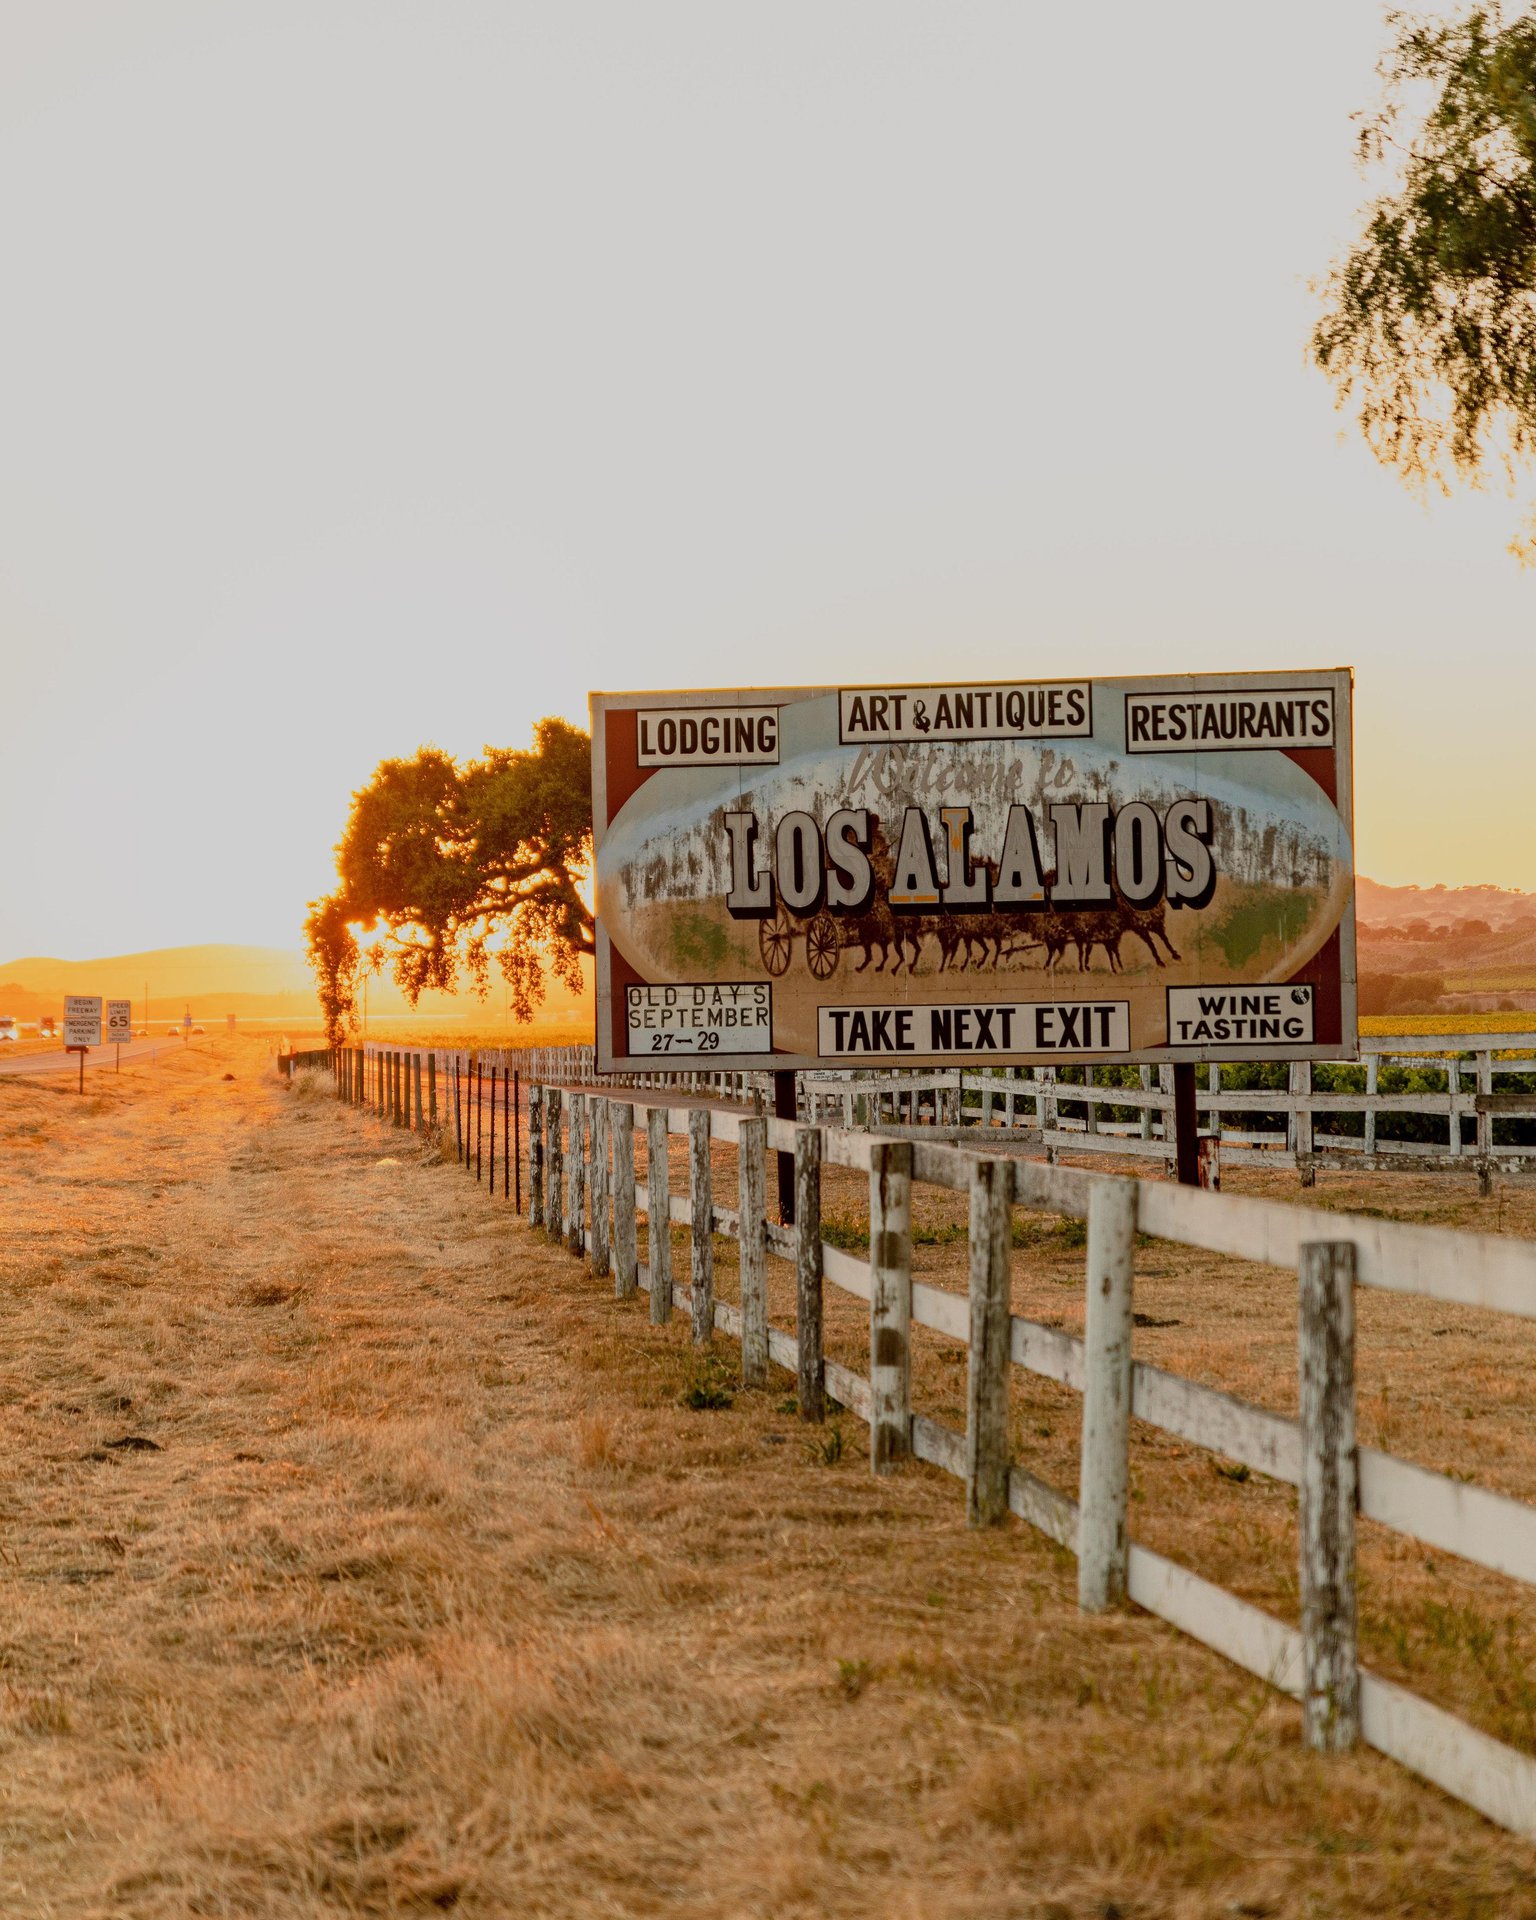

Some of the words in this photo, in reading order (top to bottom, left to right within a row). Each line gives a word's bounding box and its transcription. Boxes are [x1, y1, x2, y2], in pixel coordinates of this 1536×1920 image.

[848, 694, 907, 732] ART
[913, 700, 930, 734] &
[933, 688, 1086, 731] ANTIQUES
[1131, 699, 1331, 742] RESTAURANTS
[640, 715, 777, 756] LODGING
[849, 744, 1023, 794] Welcome
[1038, 749, 1074, 789] to
[724, 808, 875, 920] LOS
[888, 799, 1217, 916] ALAMOS
[629, 986, 678, 1007] OLD
[1198, 995, 1282, 1016] WINE
[109, 1016, 128, 1027] 65
[629, 1006, 769, 1029] SEPTEMBER
[829, 1010, 915, 1052] TAKE
[931, 1008, 1017, 1050] NEXT
[1035, 1006, 1116, 1049] EXIT
[1177, 1017, 1304, 1041] TASTING
